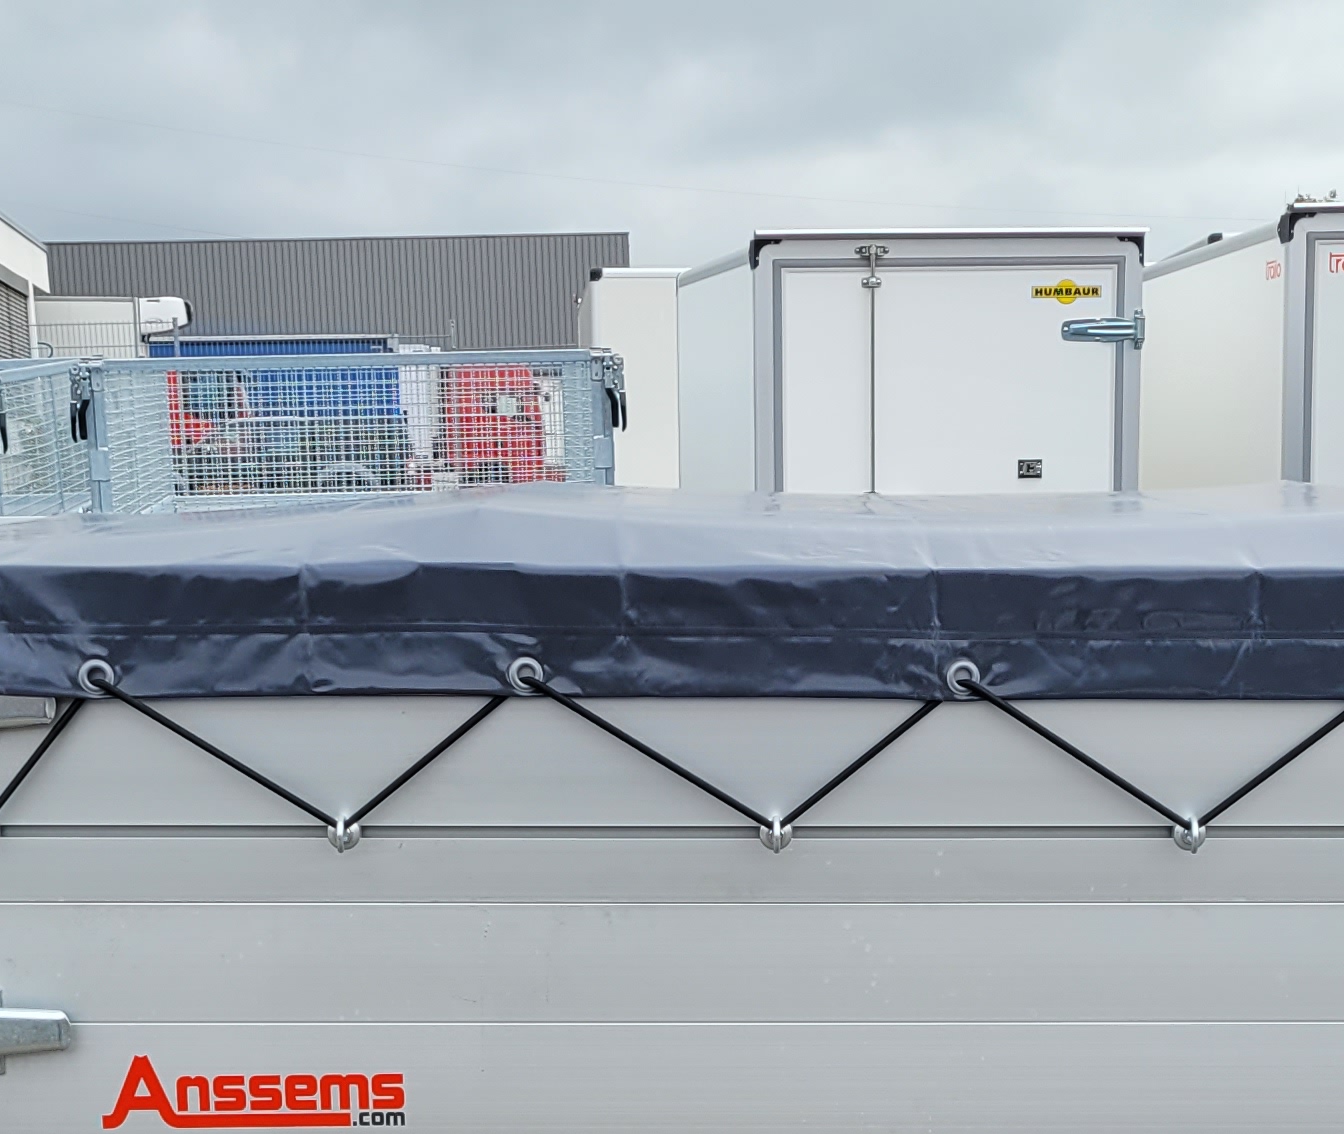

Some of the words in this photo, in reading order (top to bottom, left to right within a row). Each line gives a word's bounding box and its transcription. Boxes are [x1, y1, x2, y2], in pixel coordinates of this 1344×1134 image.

[1035, 287, 1099, 297] HUMBAUR
[102, 1054, 405, 1129] Anssems
[352, 1111, 406, 1127] .com
